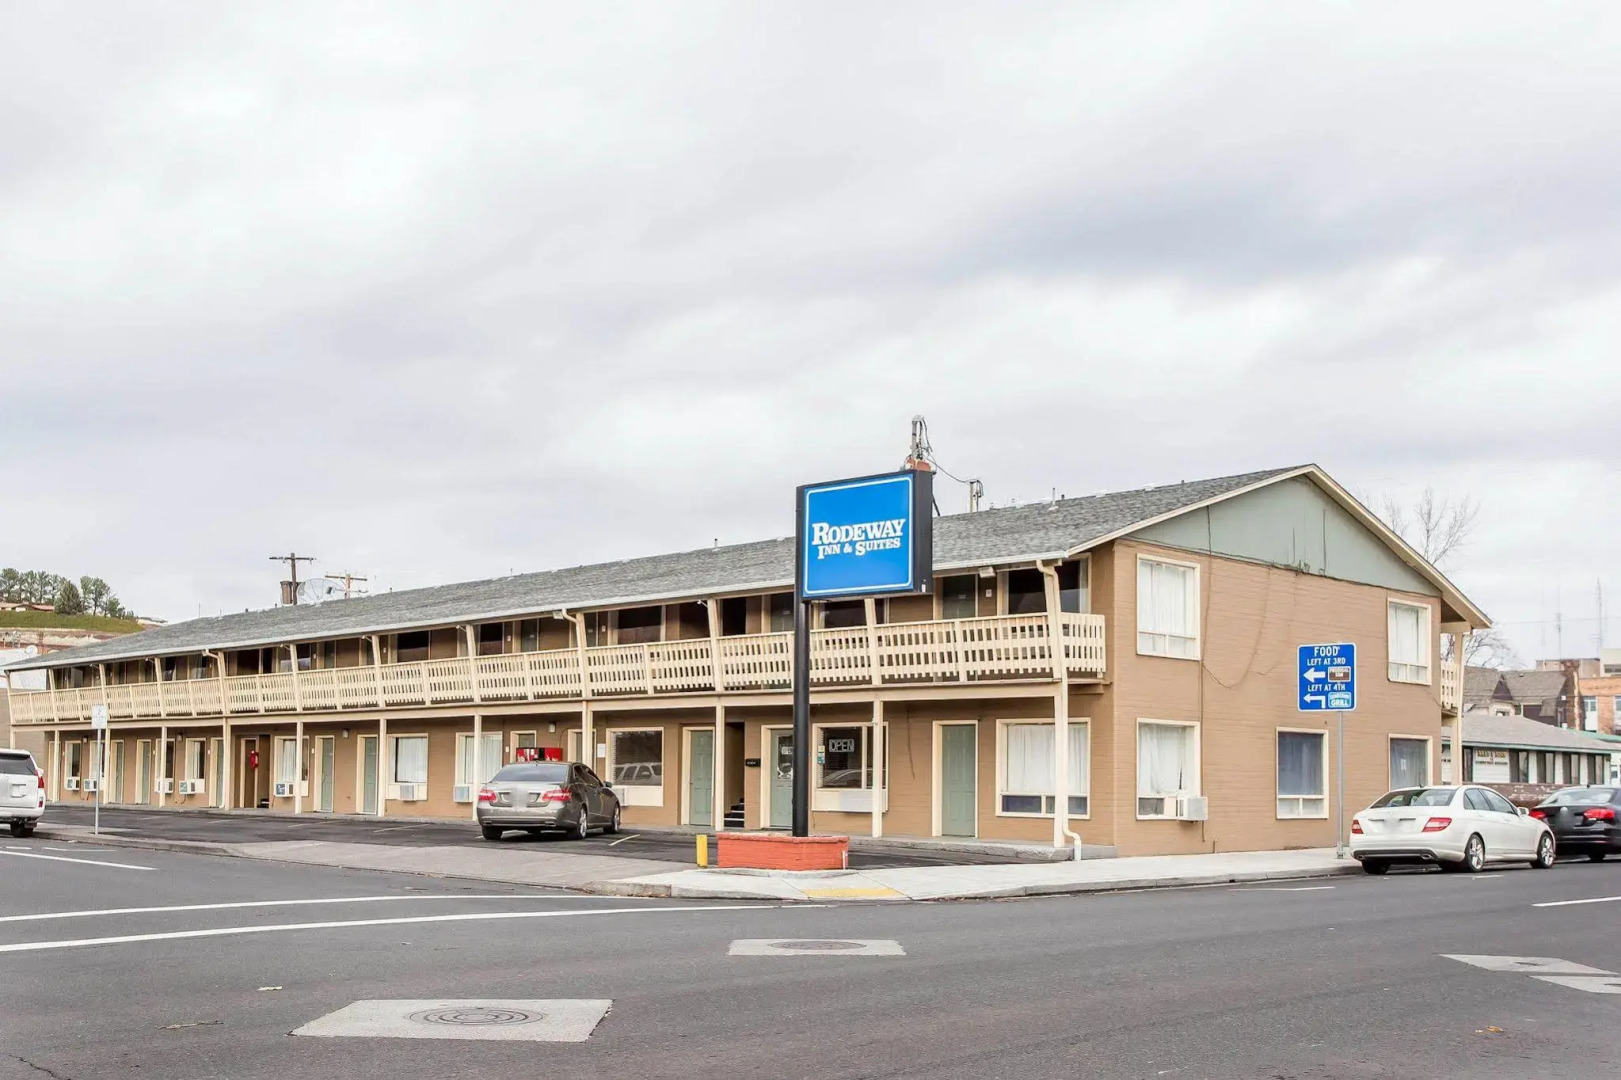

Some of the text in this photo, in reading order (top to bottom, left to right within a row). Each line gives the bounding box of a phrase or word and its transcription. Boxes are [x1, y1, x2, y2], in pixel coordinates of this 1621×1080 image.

[812, 519, 905, 545] RODEWAY
[817, 537, 901, 560] INN & SUITES
[1314, 646, 1338, 656] FOOD
[1308, 684, 1322, 692] LEFT
[830, 740, 854, 752] OPEN
